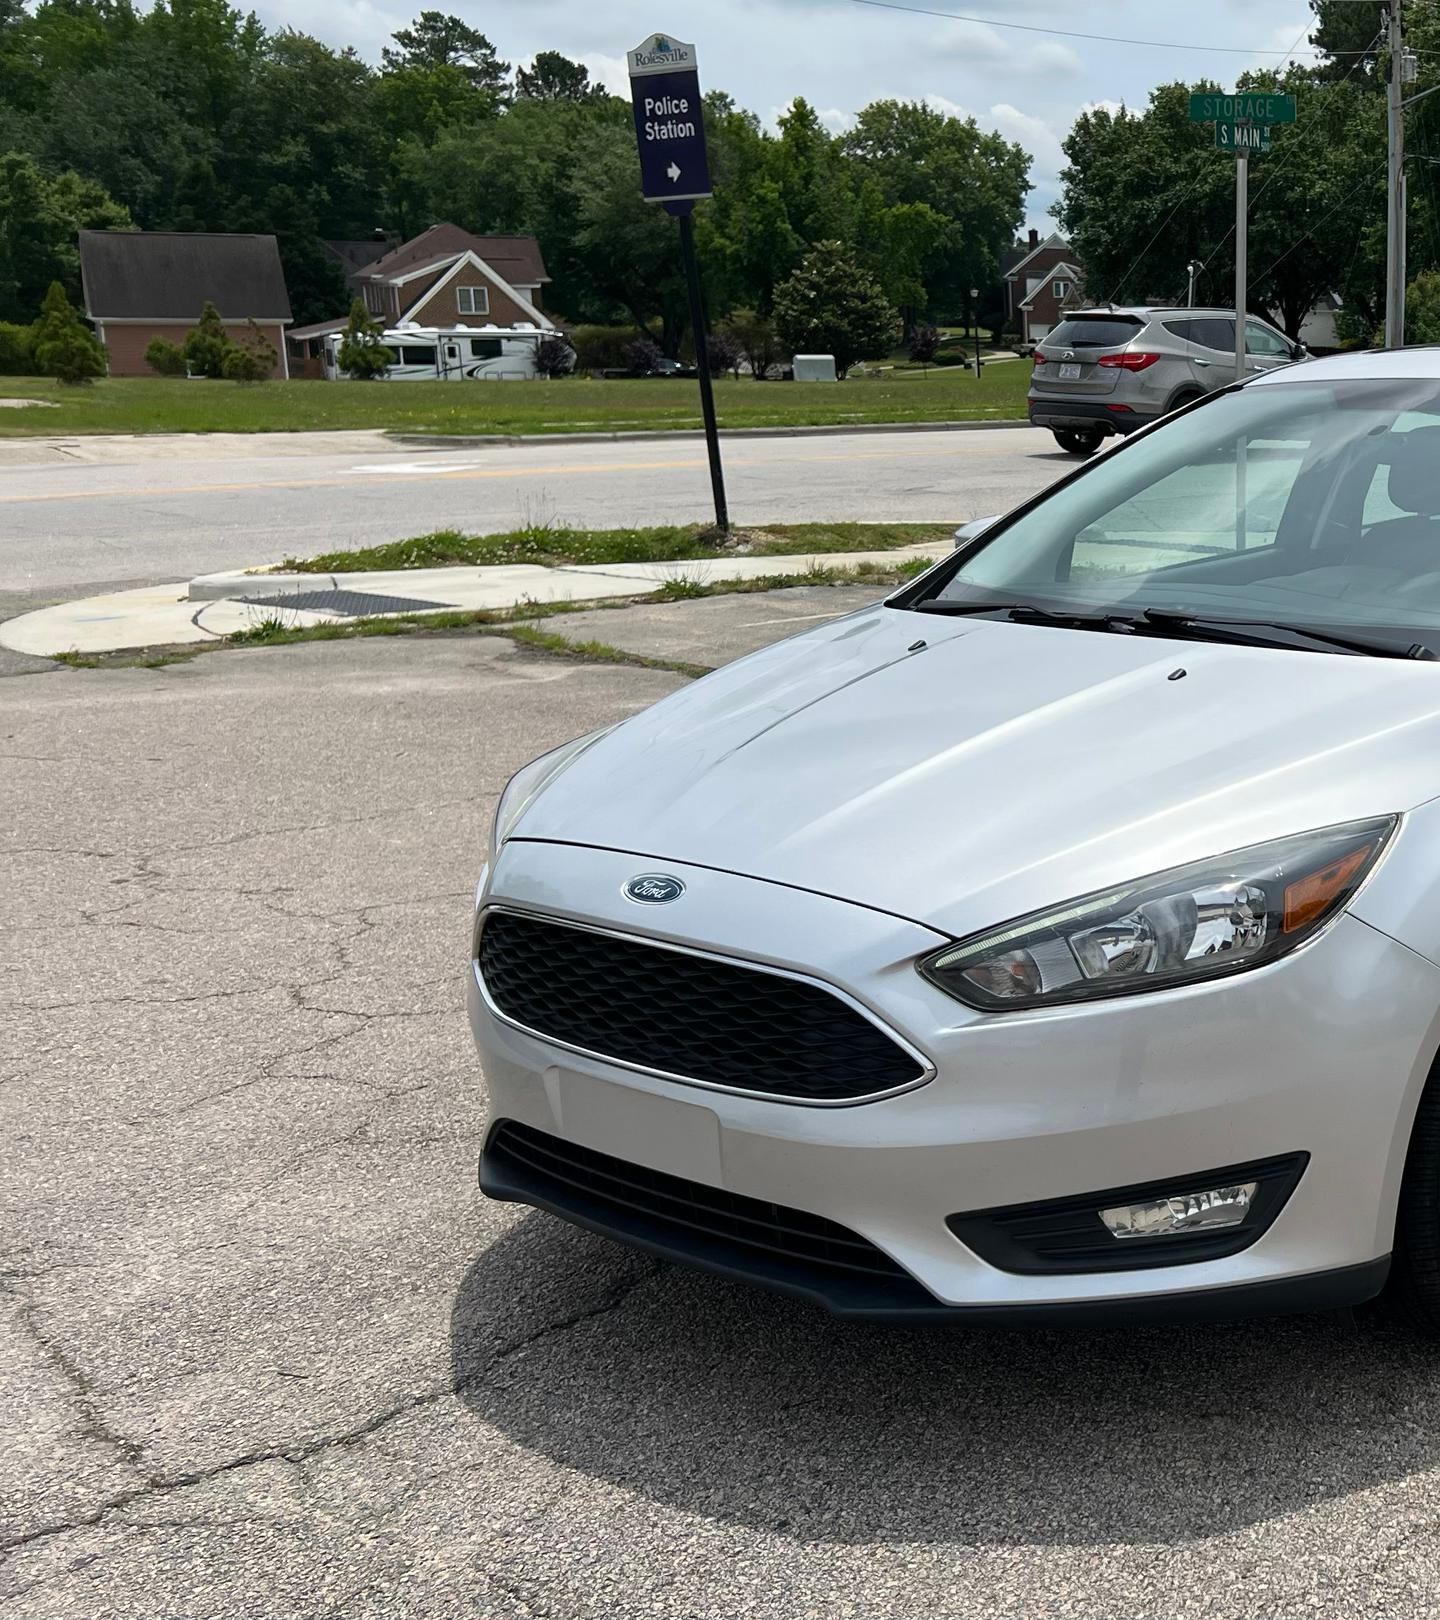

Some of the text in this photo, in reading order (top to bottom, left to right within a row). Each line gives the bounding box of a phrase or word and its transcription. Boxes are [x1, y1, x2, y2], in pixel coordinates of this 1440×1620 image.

[645, 96, 689, 117] Police
[1203, 98, 1274, 118] STORAGE
[645, 121, 695, 141] Station
[1221, 124, 1228, 144] S
[1234, 126, 1260, 148] MAIN
[634, 880, 671, 898] Ford
